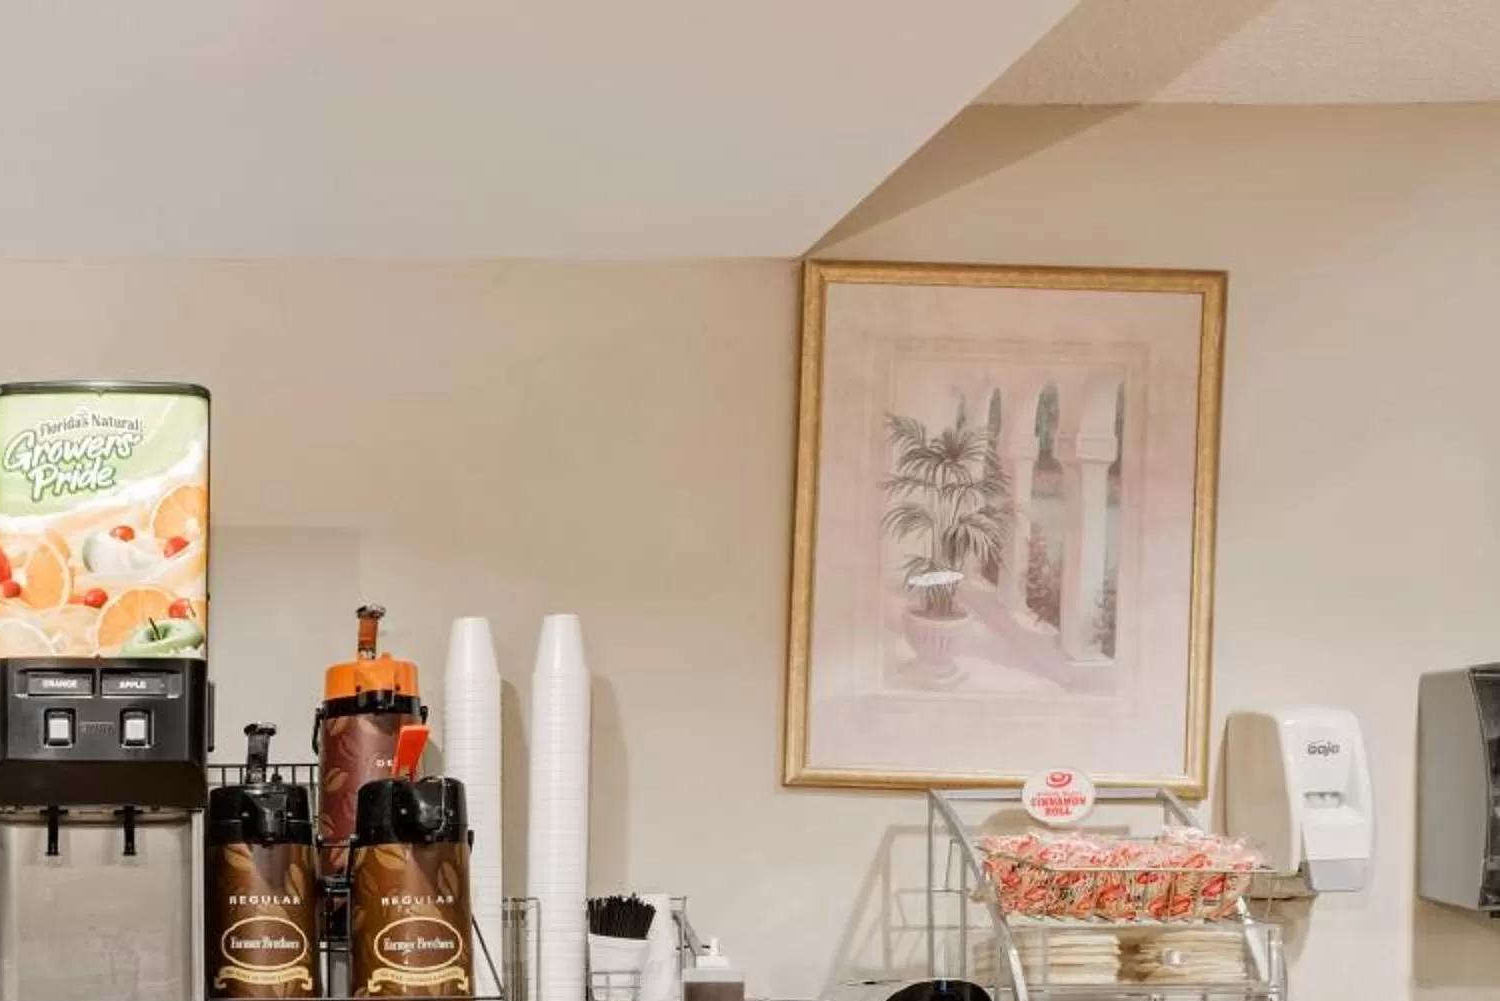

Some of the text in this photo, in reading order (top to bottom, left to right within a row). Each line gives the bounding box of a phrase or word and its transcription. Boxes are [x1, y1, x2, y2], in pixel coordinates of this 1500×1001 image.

[26, 457, 117, 503] Pride
[229, 895, 301, 905] REGULAR
[381, 895, 453, 906] REGULAR
